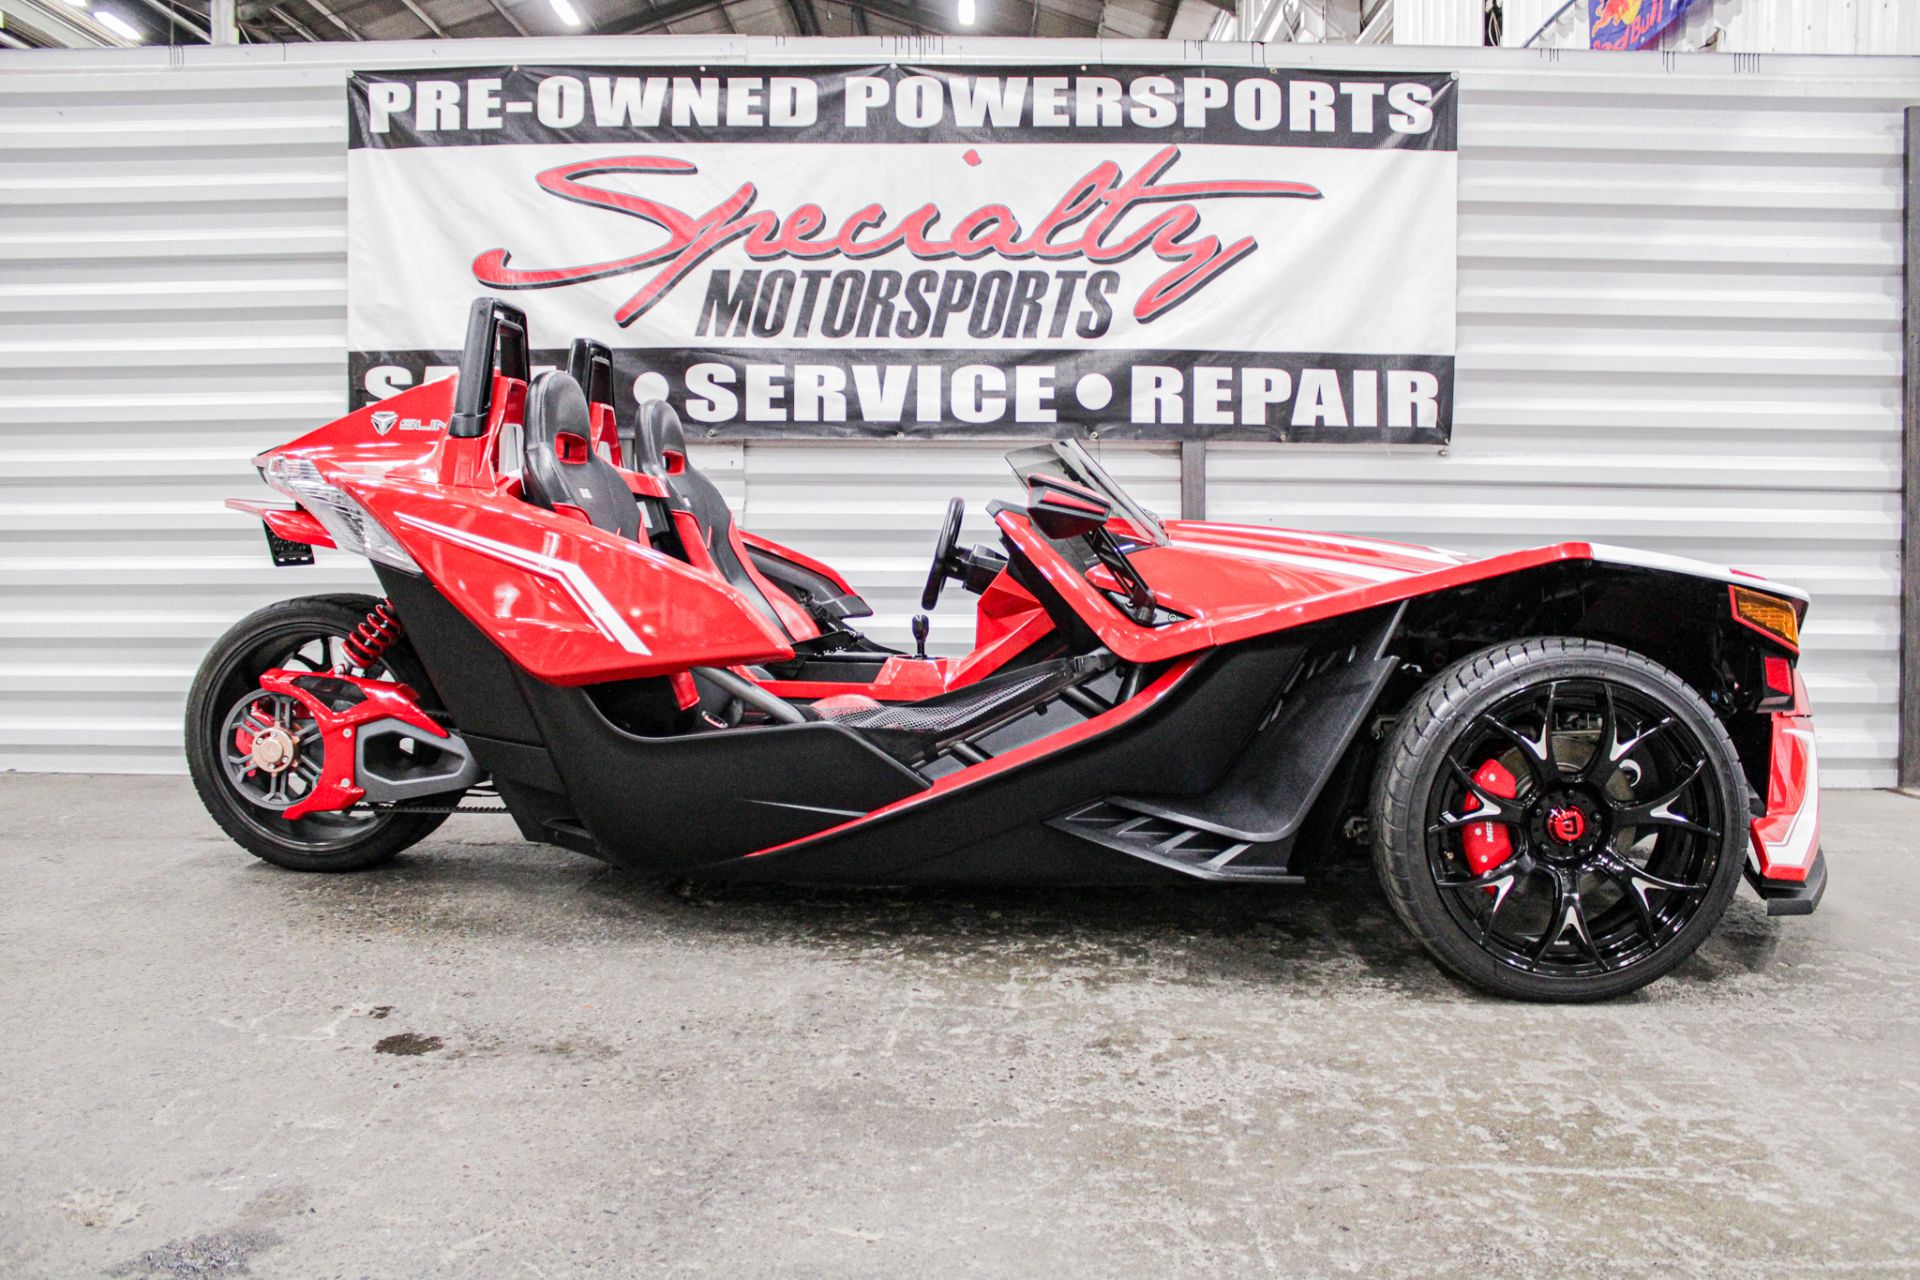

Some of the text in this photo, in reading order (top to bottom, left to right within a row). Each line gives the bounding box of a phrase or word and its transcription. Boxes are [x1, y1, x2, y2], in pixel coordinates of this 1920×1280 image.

[367, 76, 1435, 136] PRE-OWNED POWERSPORTS
[472, 144, 1324, 328] Specialty
[694, 268, 1121, 339] MOTORSPORTS
[684, 362, 1439, 428] SERVICE REPAIR
